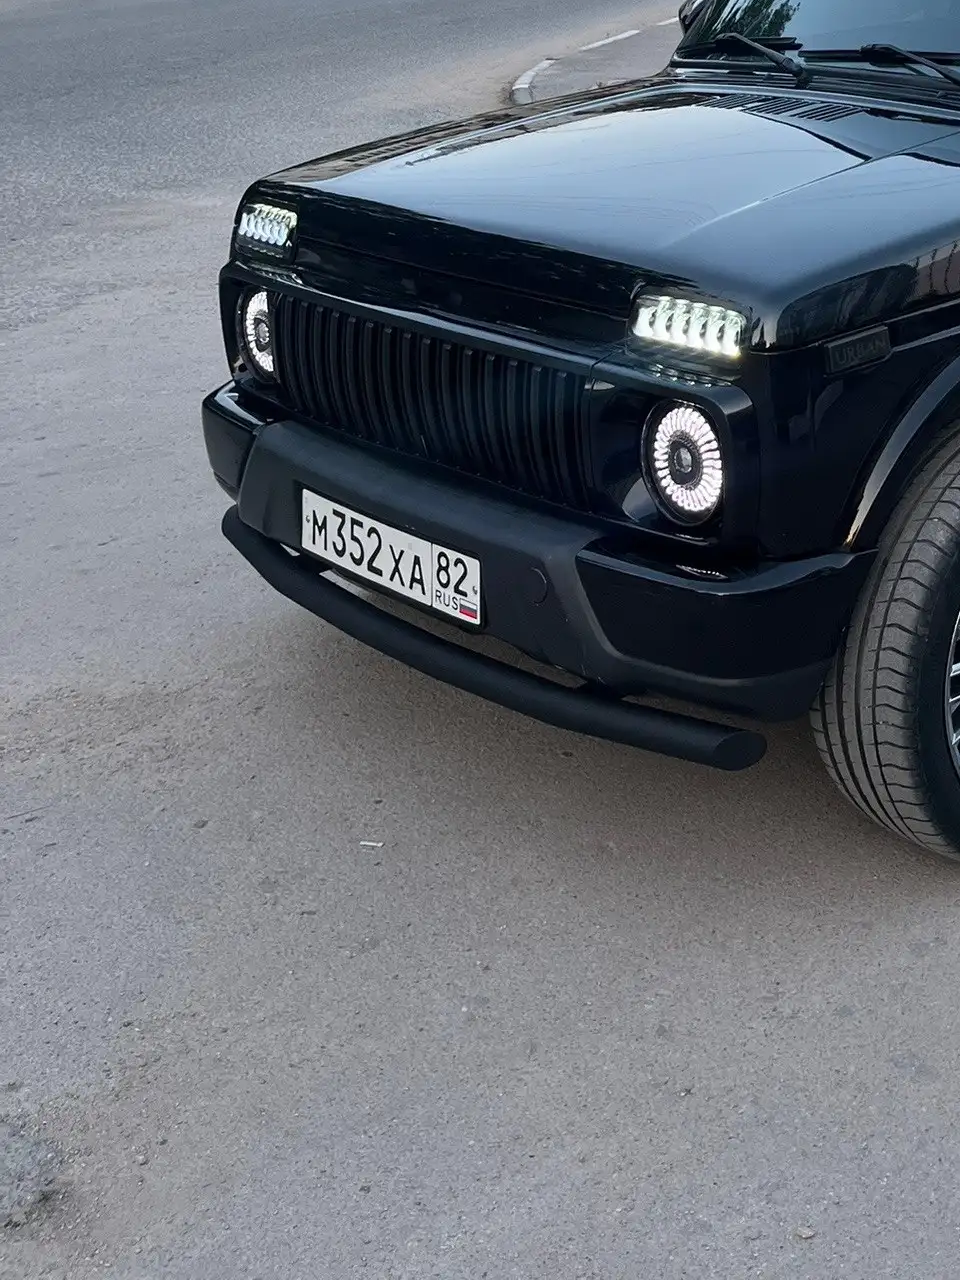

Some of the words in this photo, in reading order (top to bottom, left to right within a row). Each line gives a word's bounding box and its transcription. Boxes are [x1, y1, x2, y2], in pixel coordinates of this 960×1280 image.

[312, 508, 426, 596] М352ХА
[436, 551, 468, 597] 82
[435, 589, 459, 611] RUS
